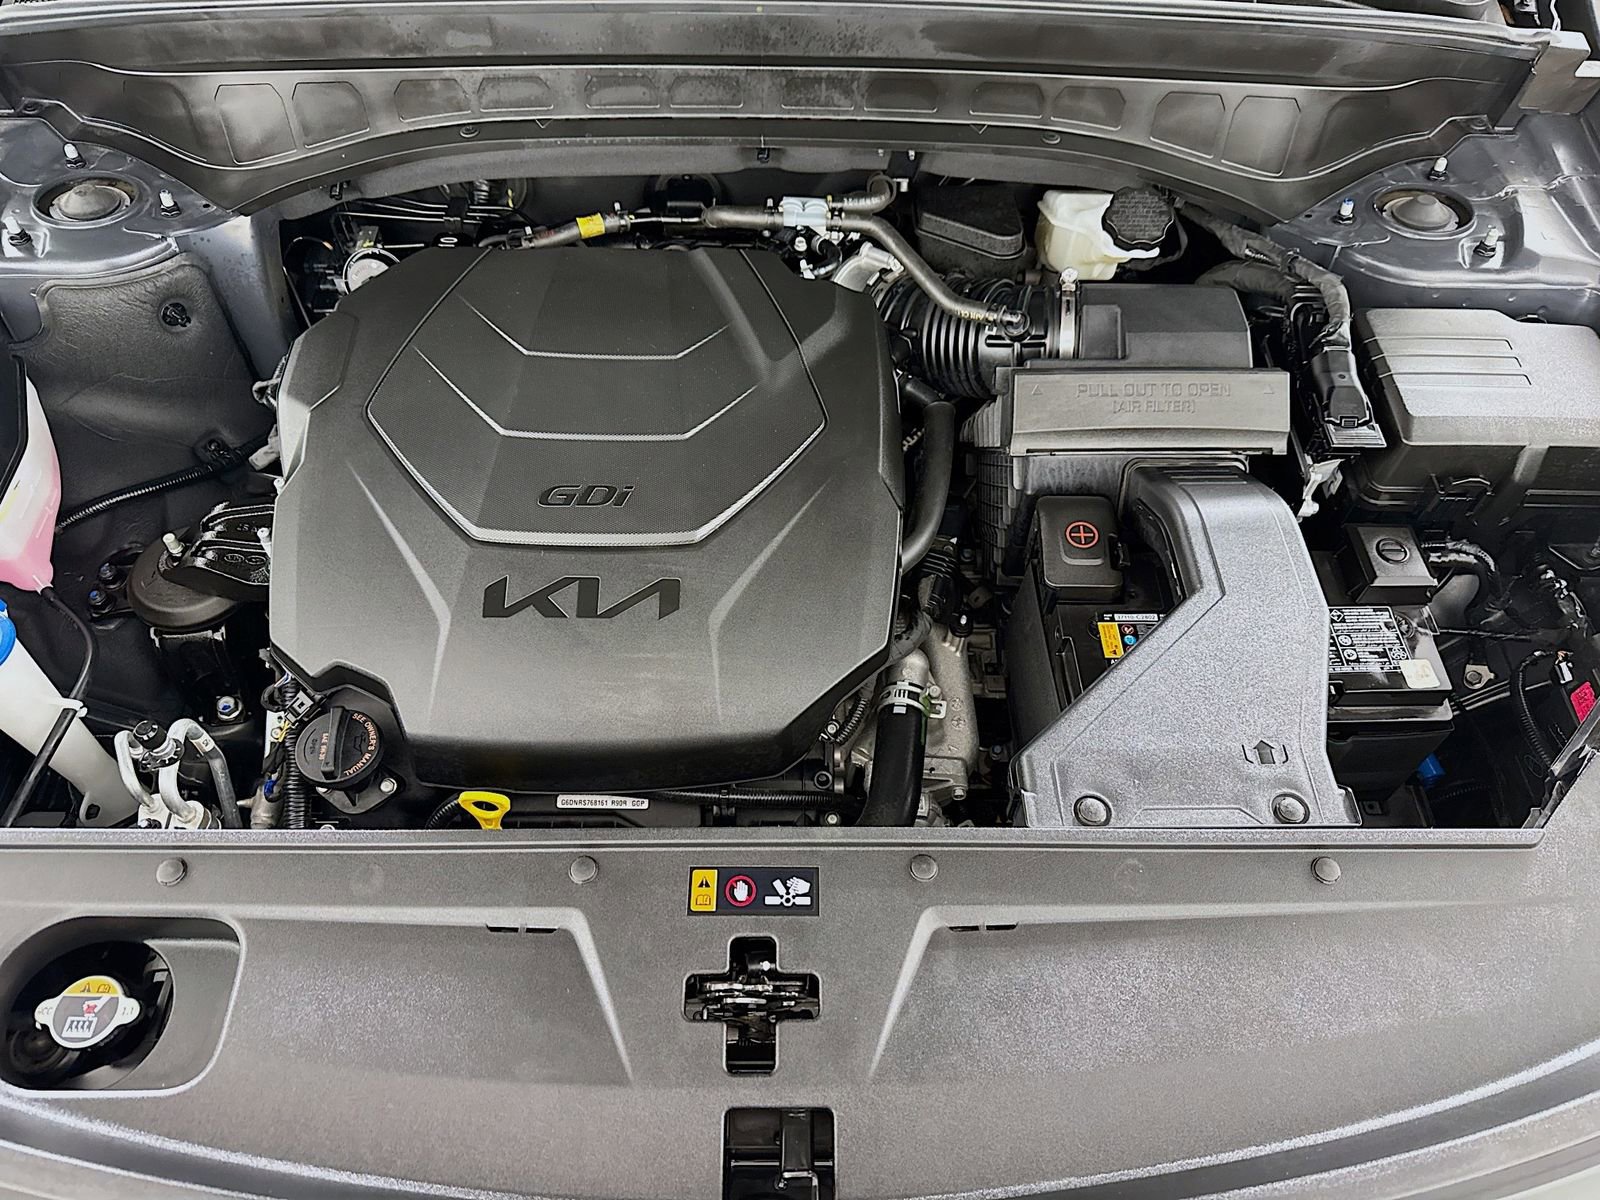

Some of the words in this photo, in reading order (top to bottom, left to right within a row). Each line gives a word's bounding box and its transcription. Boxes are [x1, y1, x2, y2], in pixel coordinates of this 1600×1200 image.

[1076, 383, 1118, 397] PULL
[1122, 383, 1156, 397] OUT
[1160, 383, 1184, 397] TO
[1187, 383, 1231, 397] OPEN
[537, 484, 636, 508] GDi
[482, 574, 682, 620] KIA
[352, 713, 366, 723] SEE
[344, 753, 371, 775] MANUAL
